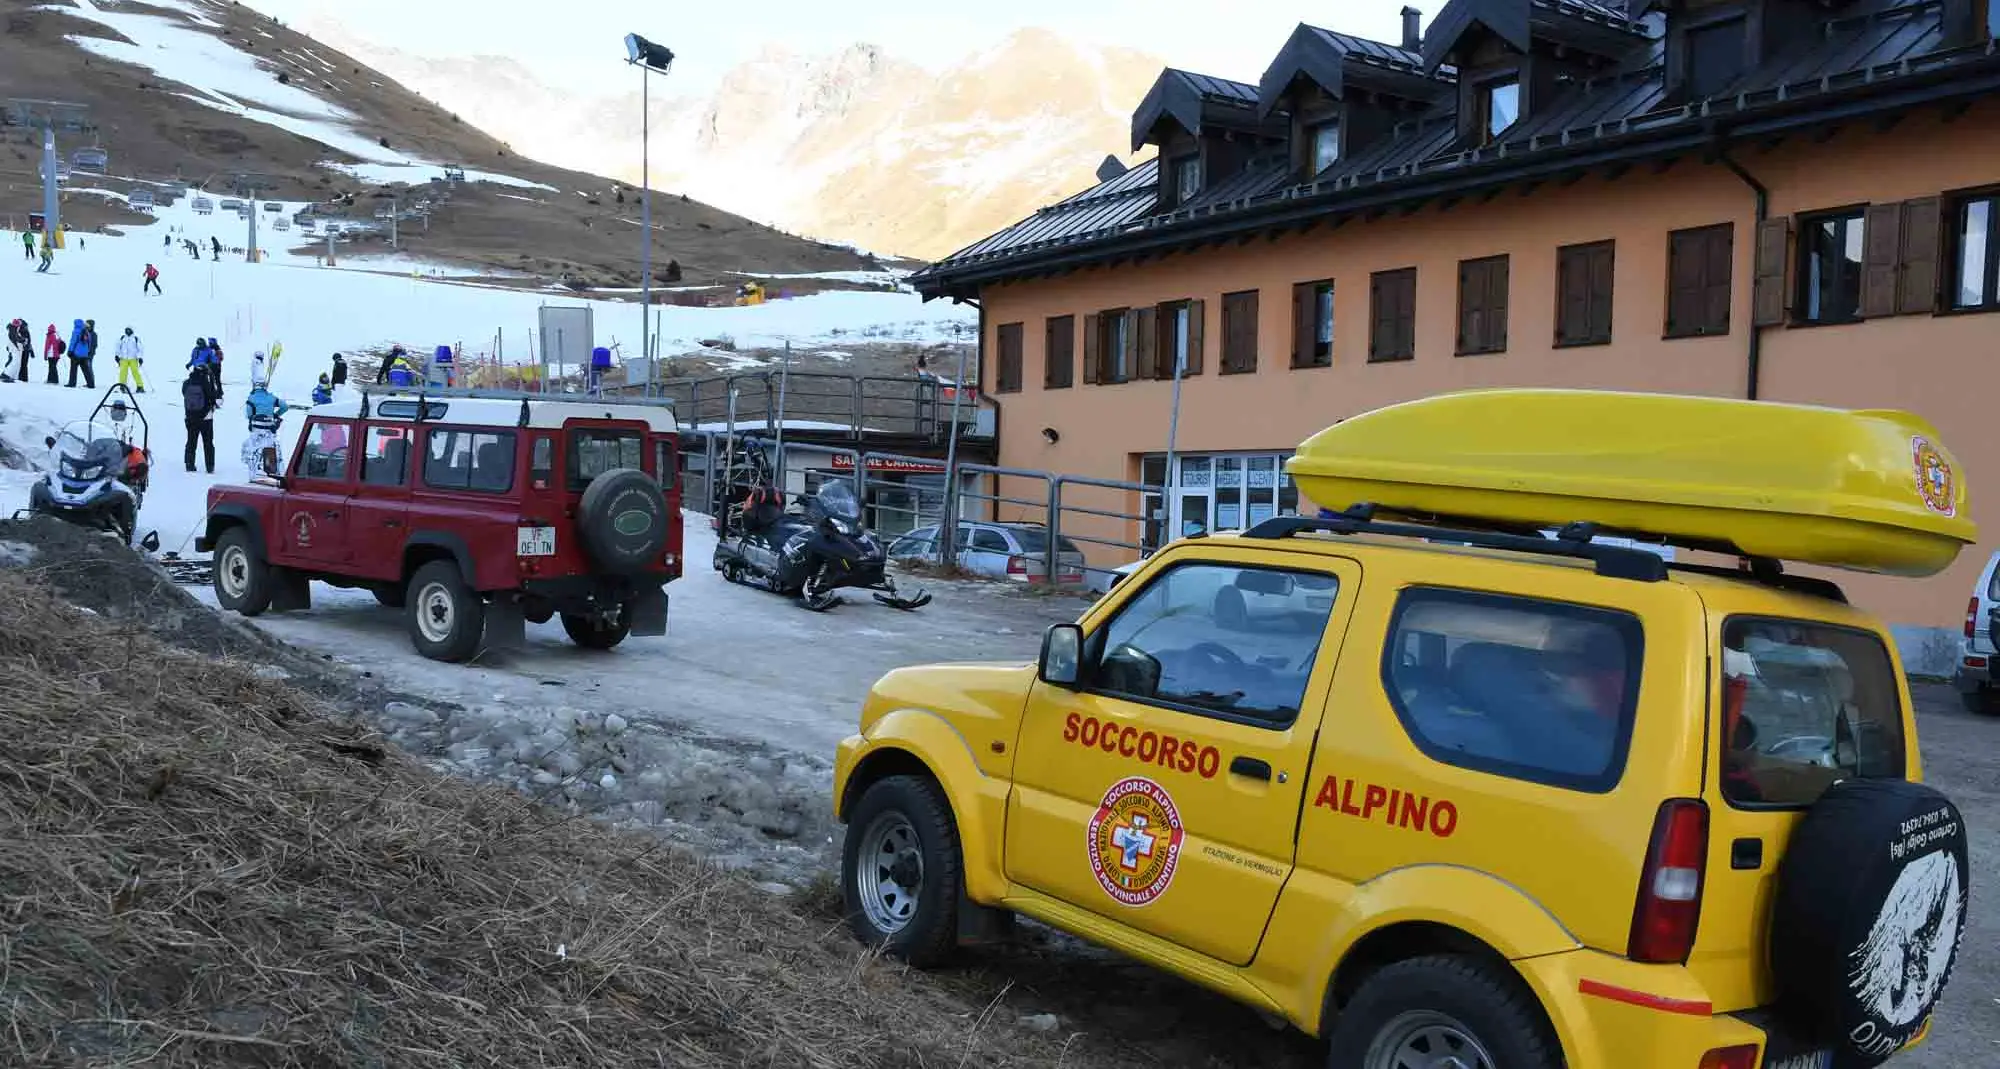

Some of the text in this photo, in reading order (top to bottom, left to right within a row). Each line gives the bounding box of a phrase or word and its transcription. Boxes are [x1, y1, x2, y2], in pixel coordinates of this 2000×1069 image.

[835, 455, 882, 467] SALNE
[531, 528, 543, 541] VF
[542, 541, 552, 553] TN
[1063, 712, 1220, 779] SOCCORSO
[1105, 781, 1179, 829] SOCCORSO ALPINO
[1119, 795, 1150, 810] SOCCORSO
[1152, 805, 1170, 832] ALPINO
[1314, 774, 1457, 838] ALPINO
[1906, 833, 1927, 854] Golgi
[1928, 822, 1957, 841] Corteno
[1089, 820, 1178, 903] SERVIZIO PROVINCIALE TRENTINO
